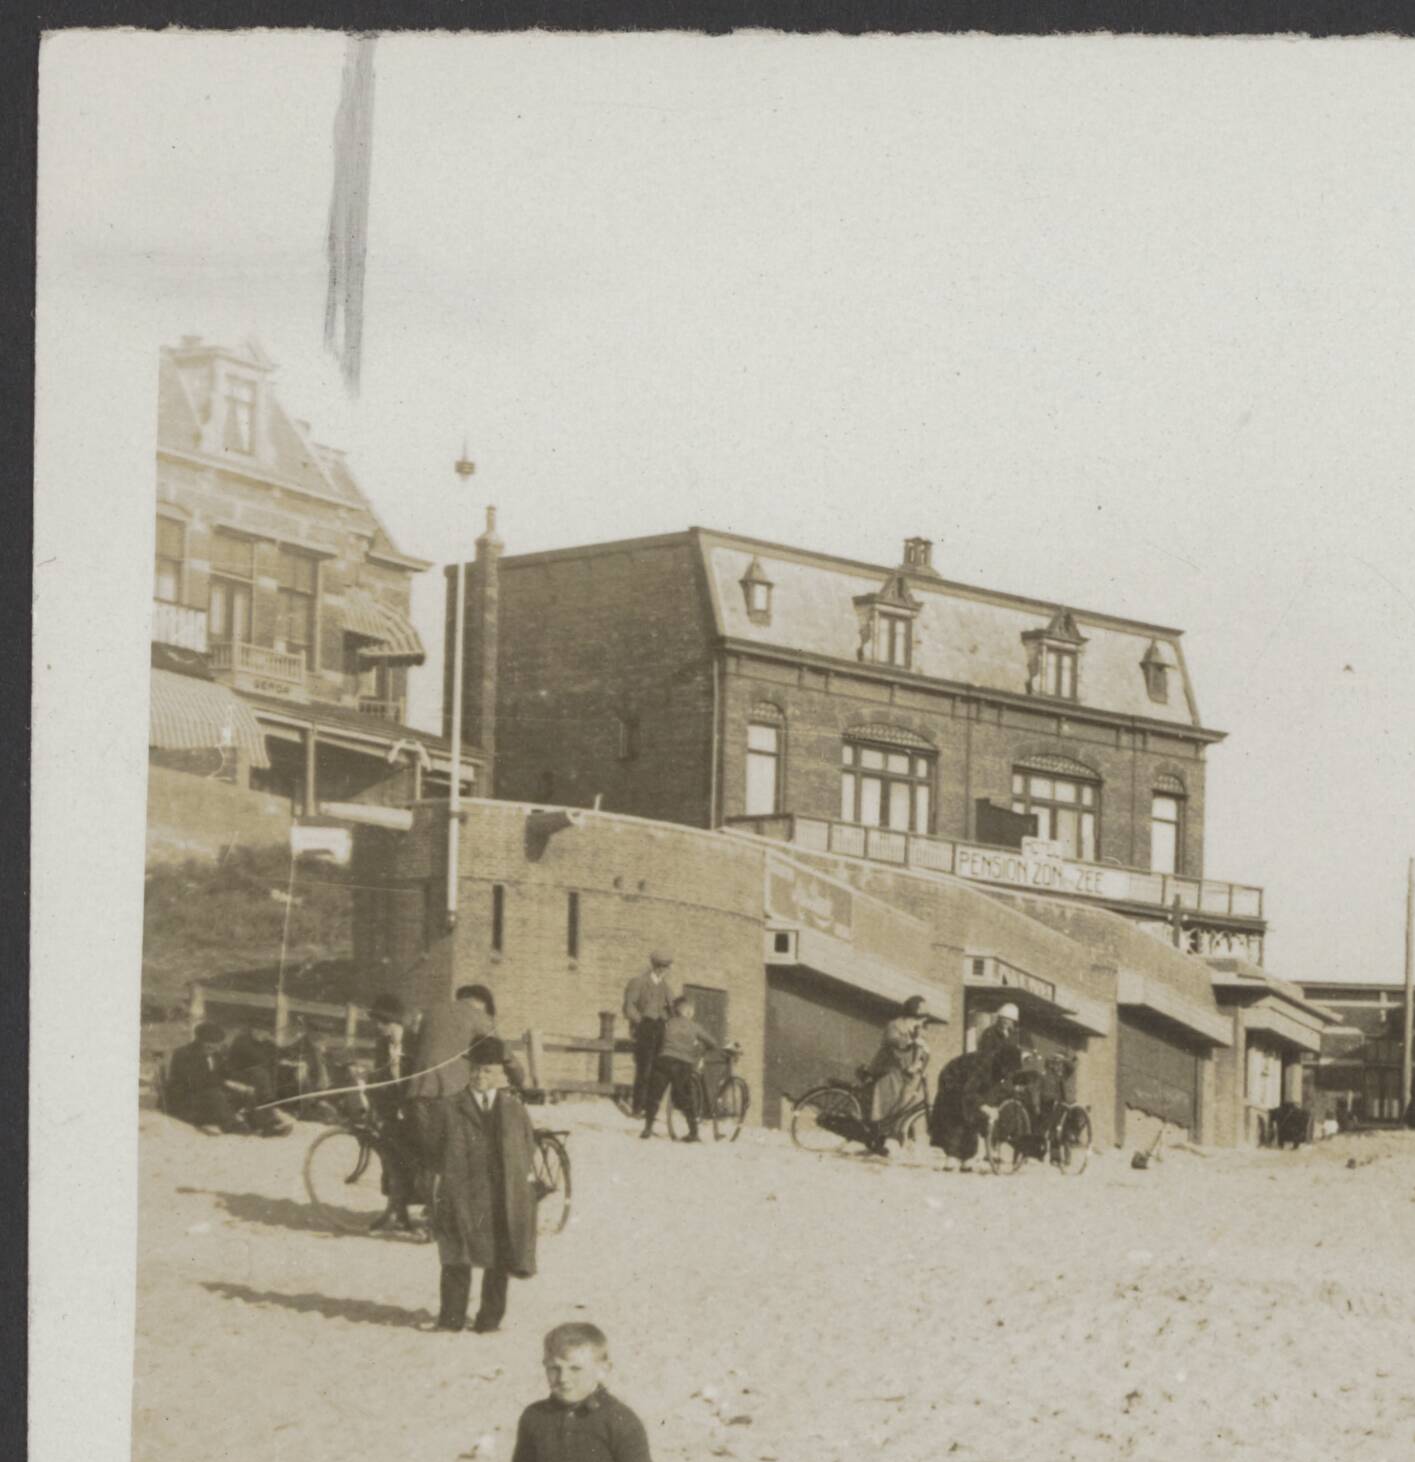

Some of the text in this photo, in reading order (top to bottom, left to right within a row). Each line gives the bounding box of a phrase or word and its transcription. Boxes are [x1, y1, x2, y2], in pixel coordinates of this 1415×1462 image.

[959, 850, 1028, 883] PENSION
[1032, 862, 1062, 888] ZON
[1075, 868, 1105, 894] ZEE
